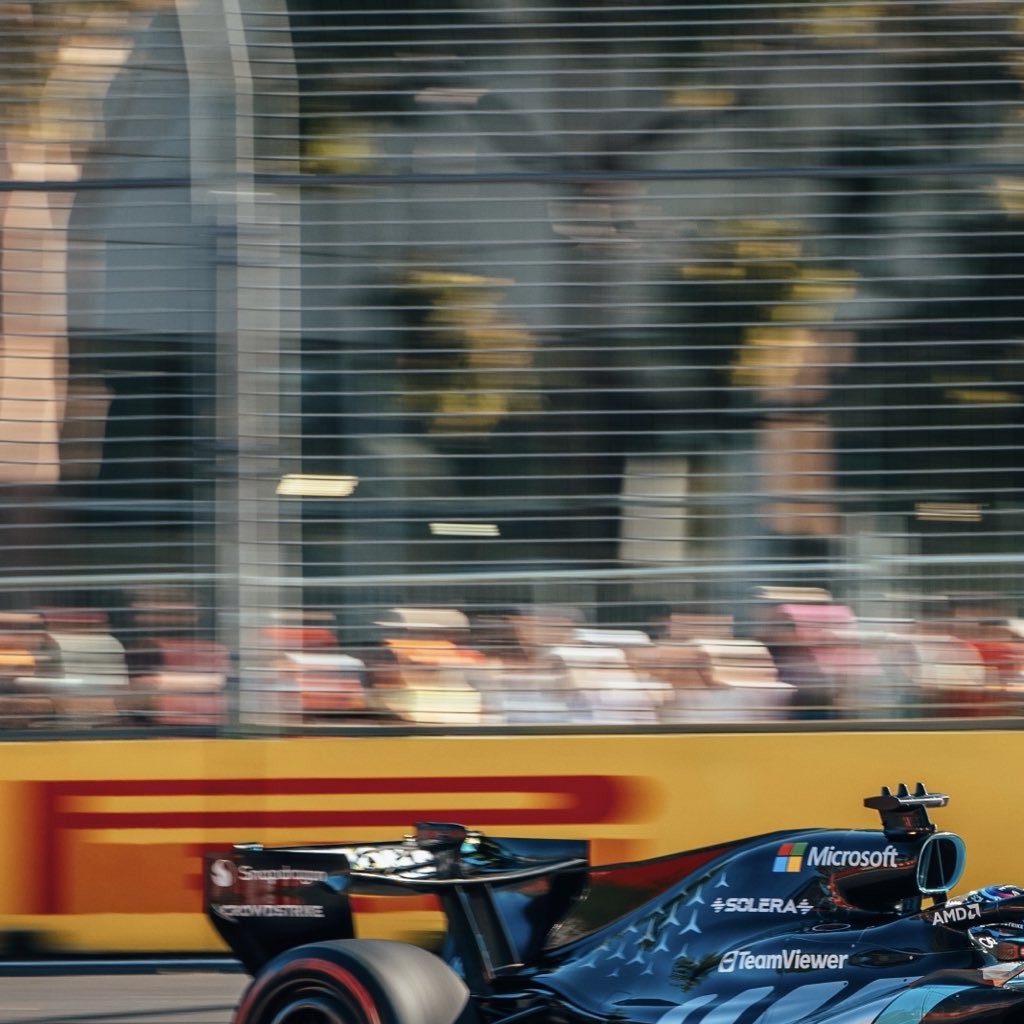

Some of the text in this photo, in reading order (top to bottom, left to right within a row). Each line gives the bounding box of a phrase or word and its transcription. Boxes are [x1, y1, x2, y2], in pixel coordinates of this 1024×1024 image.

[806, 845, 898, 867] Microsoft
[725, 898, 798, 913] SOLERA
[932, 906, 967, 926] AMD
[738, 949, 849, 970] TeamViewer
